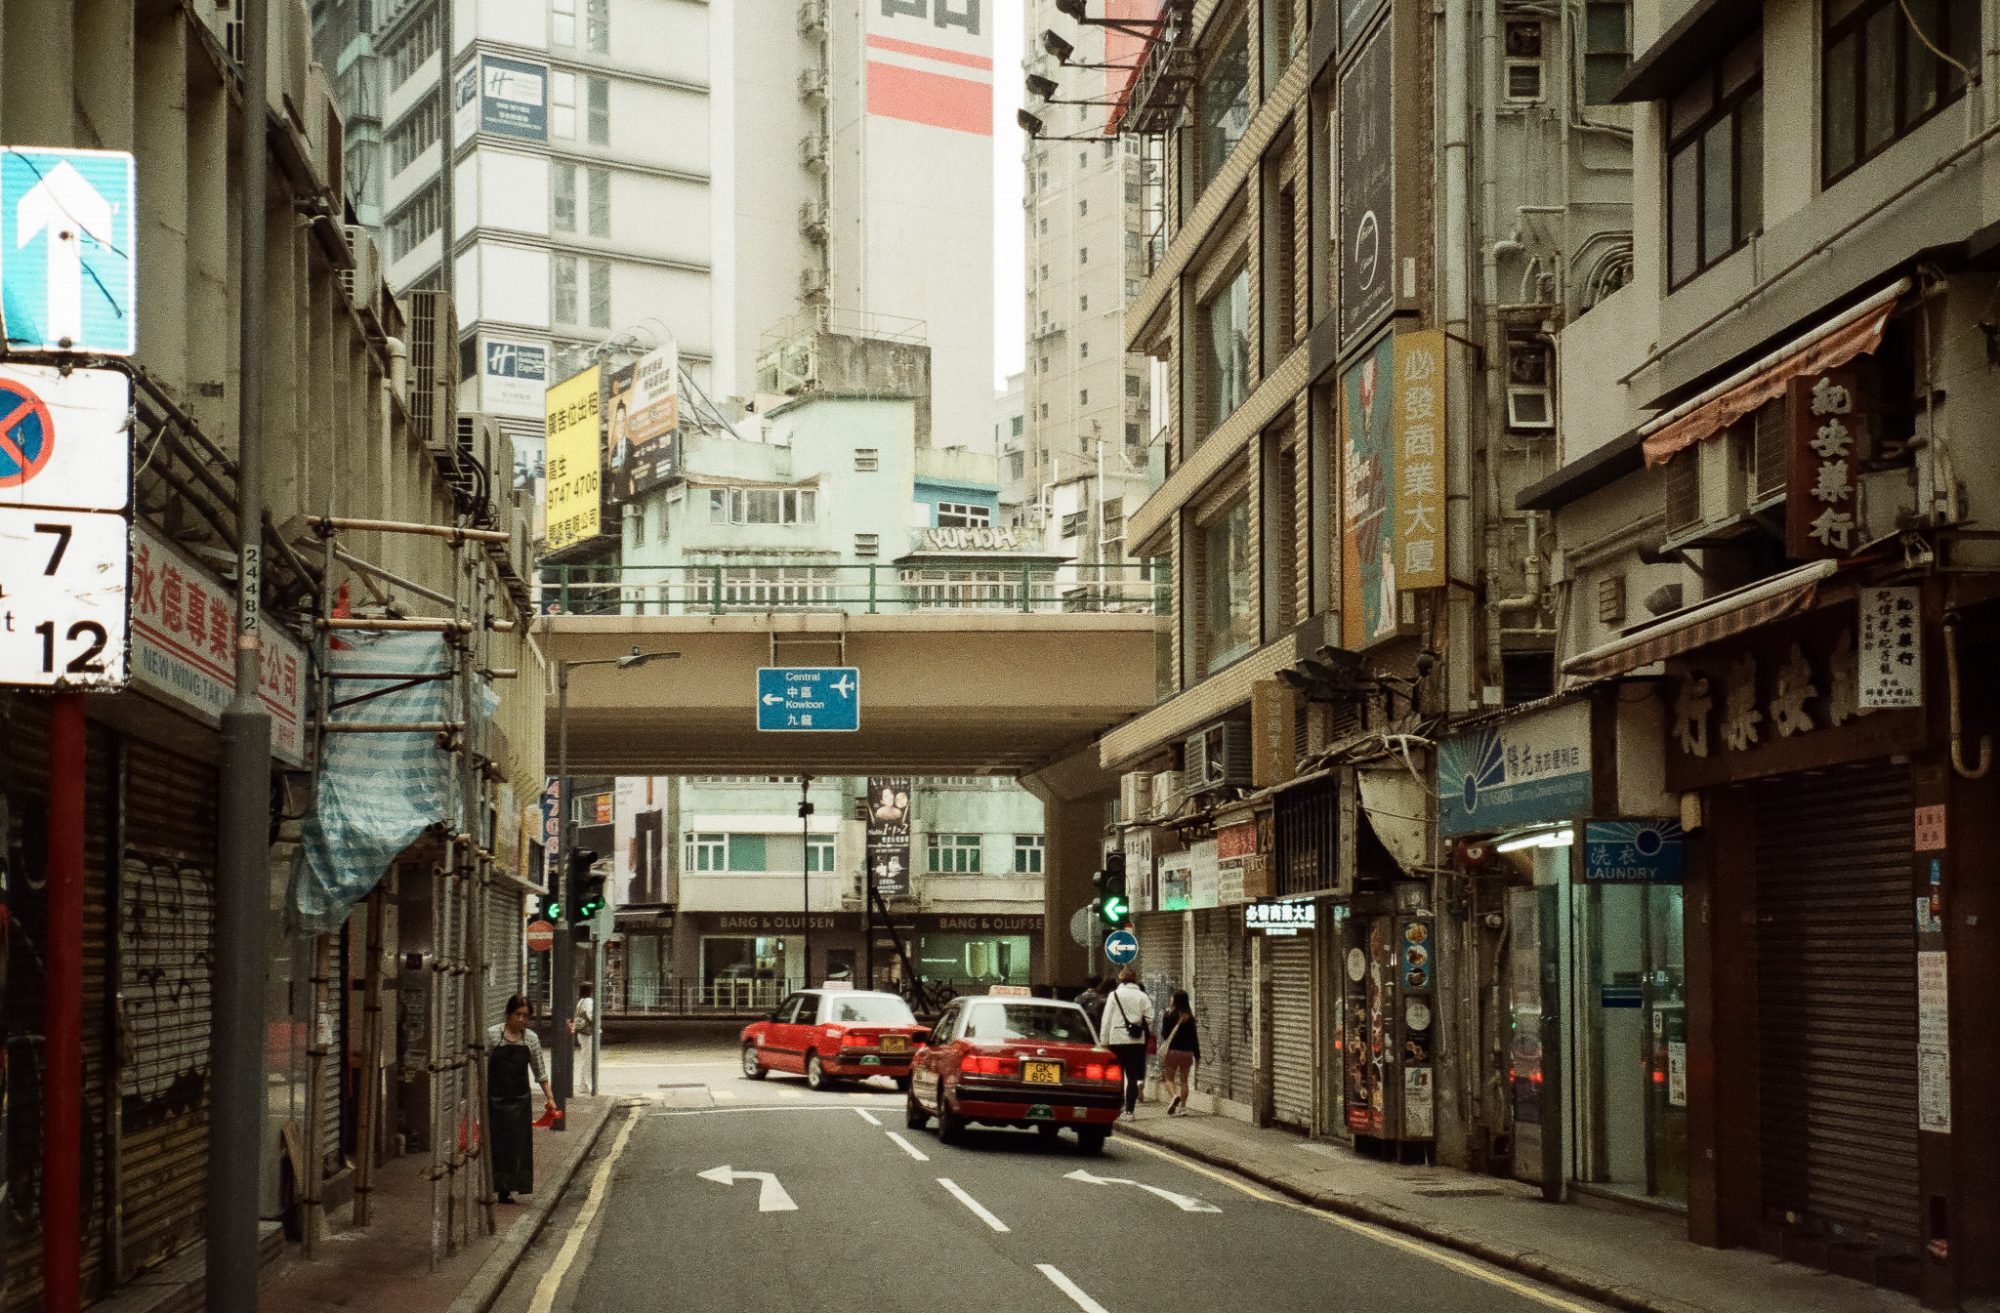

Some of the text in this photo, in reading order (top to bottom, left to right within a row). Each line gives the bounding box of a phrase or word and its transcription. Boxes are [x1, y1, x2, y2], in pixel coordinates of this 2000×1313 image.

[573, 471, 598, 497] 4706
[34, 523, 72, 576] 7
[245, 549, 258, 630] 24482
[132, 543, 297, 706] 永德專業公司
[35, 620, 108, 673] 12
[785, 672, 820, 681] Central
[785, 701, 825, 709] Kowloon
[788, 714, 813, 726] 九龍
[1591, 844, 1637, 866] 洗衣
[1585, 867, 1659, 879] LAUNDRY
[720, 917, 758, 928] BANG
[762, 918, 771, 928] &
[940, 918, 976, 929] BANG
[981, 919, 990, 929] &
